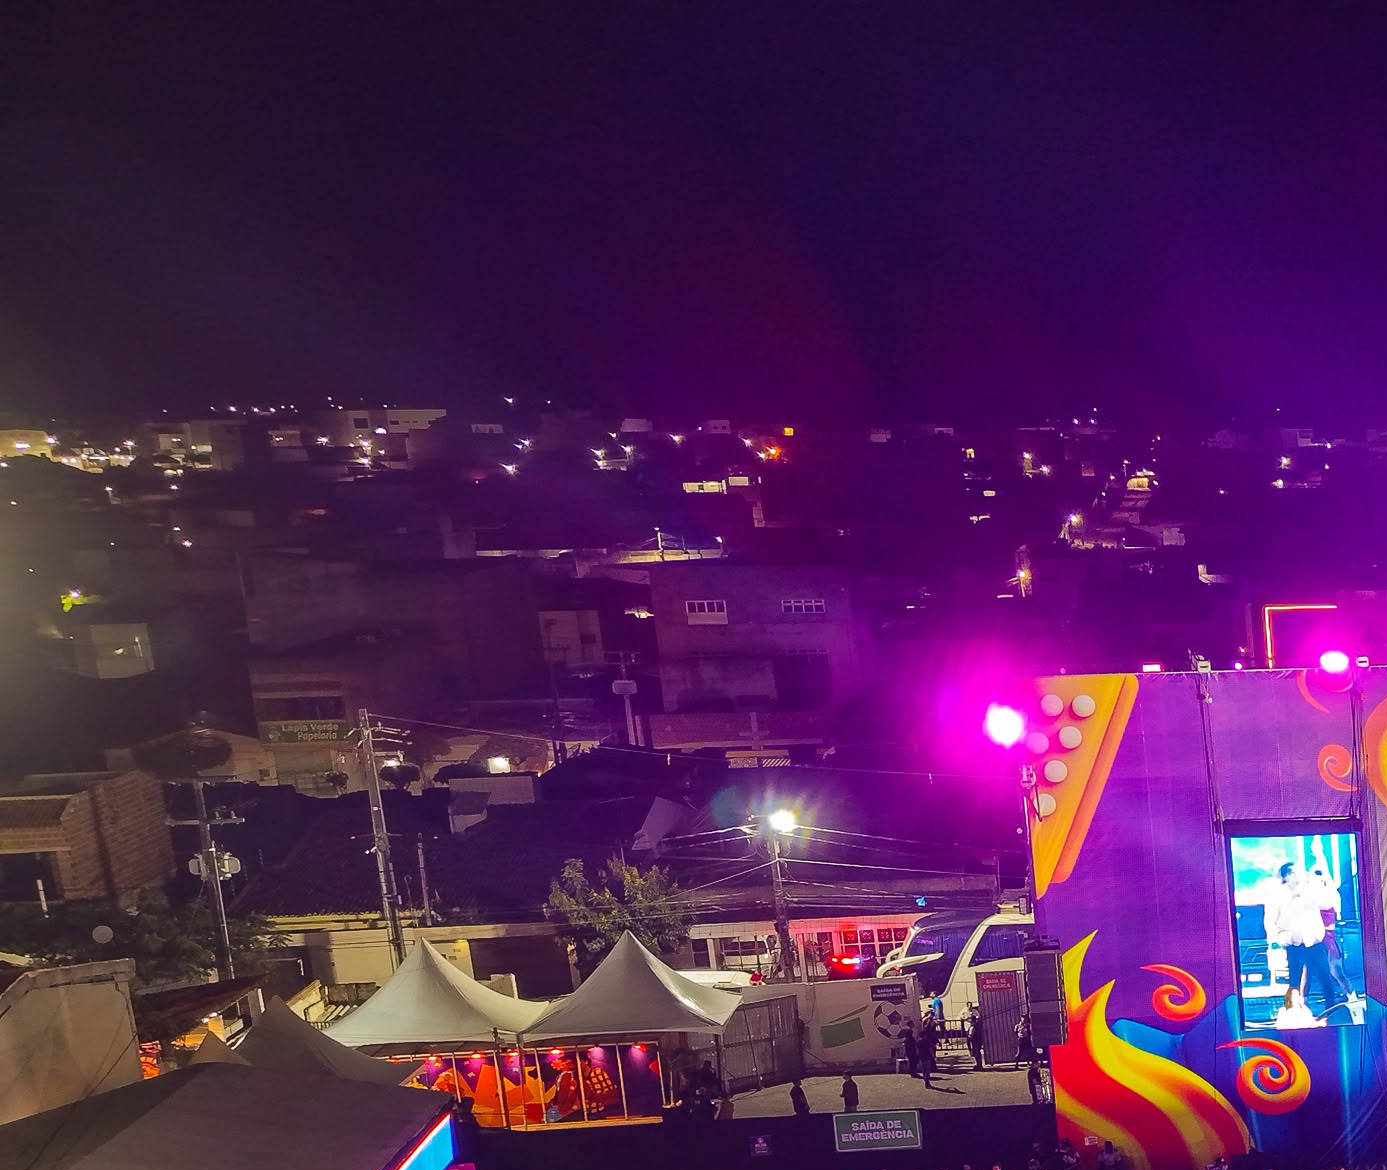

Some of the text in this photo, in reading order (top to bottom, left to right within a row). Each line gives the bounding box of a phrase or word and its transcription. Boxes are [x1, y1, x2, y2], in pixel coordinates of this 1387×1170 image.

[851, 1120, 902, 1131] SAÍDA DE
[840, 1129, 914, 1142] EMERGÊNCIA
